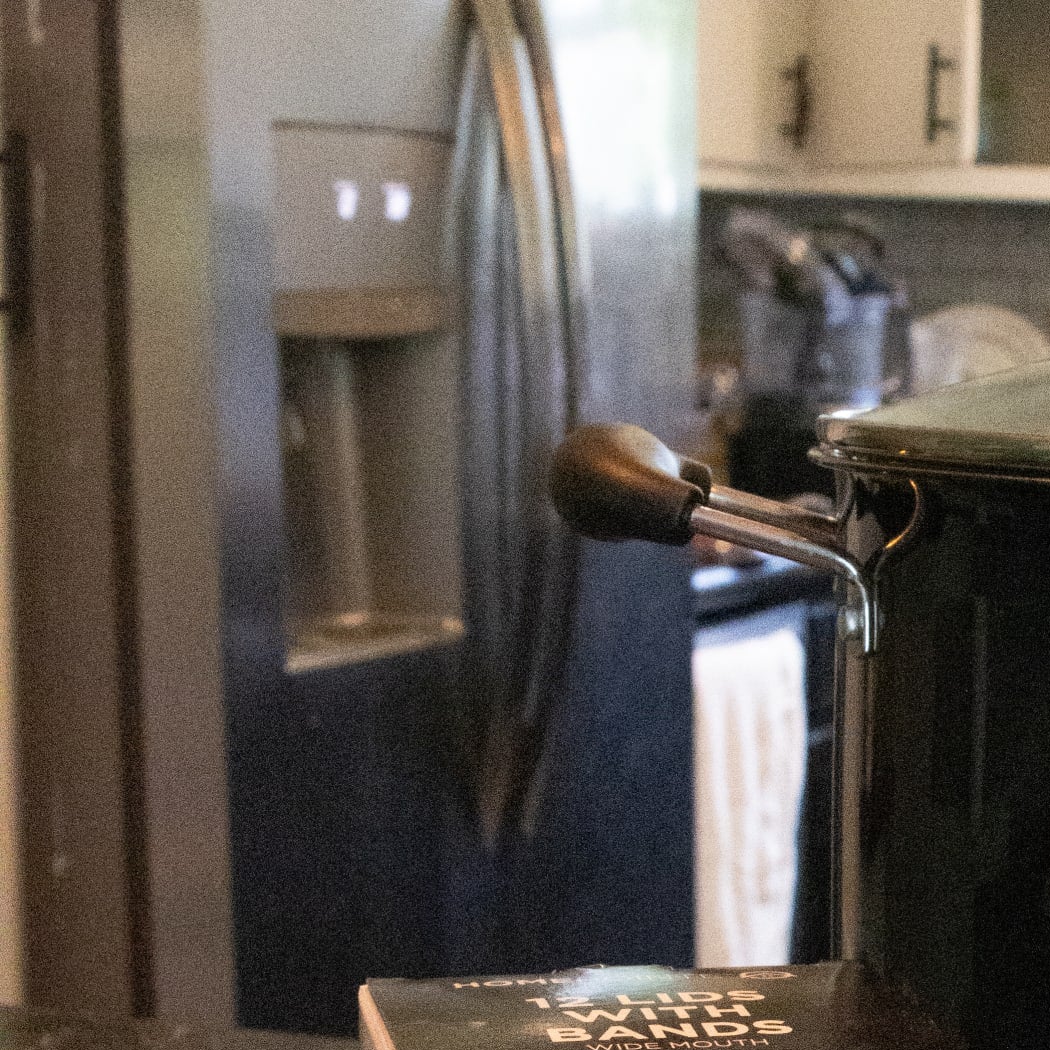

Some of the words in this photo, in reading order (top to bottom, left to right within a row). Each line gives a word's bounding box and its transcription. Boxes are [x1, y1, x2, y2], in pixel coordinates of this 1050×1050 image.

[525, 997, 594, 1009] 12
[616, 990, 765, 1005] LIDS
[563, 1004, 751, 1023] WITH
[547, 1019, 793, 1042] BANDS
[586, 1041, 661, 1050] WIDE
[669, 1038, 769, 1049] MOUTH
